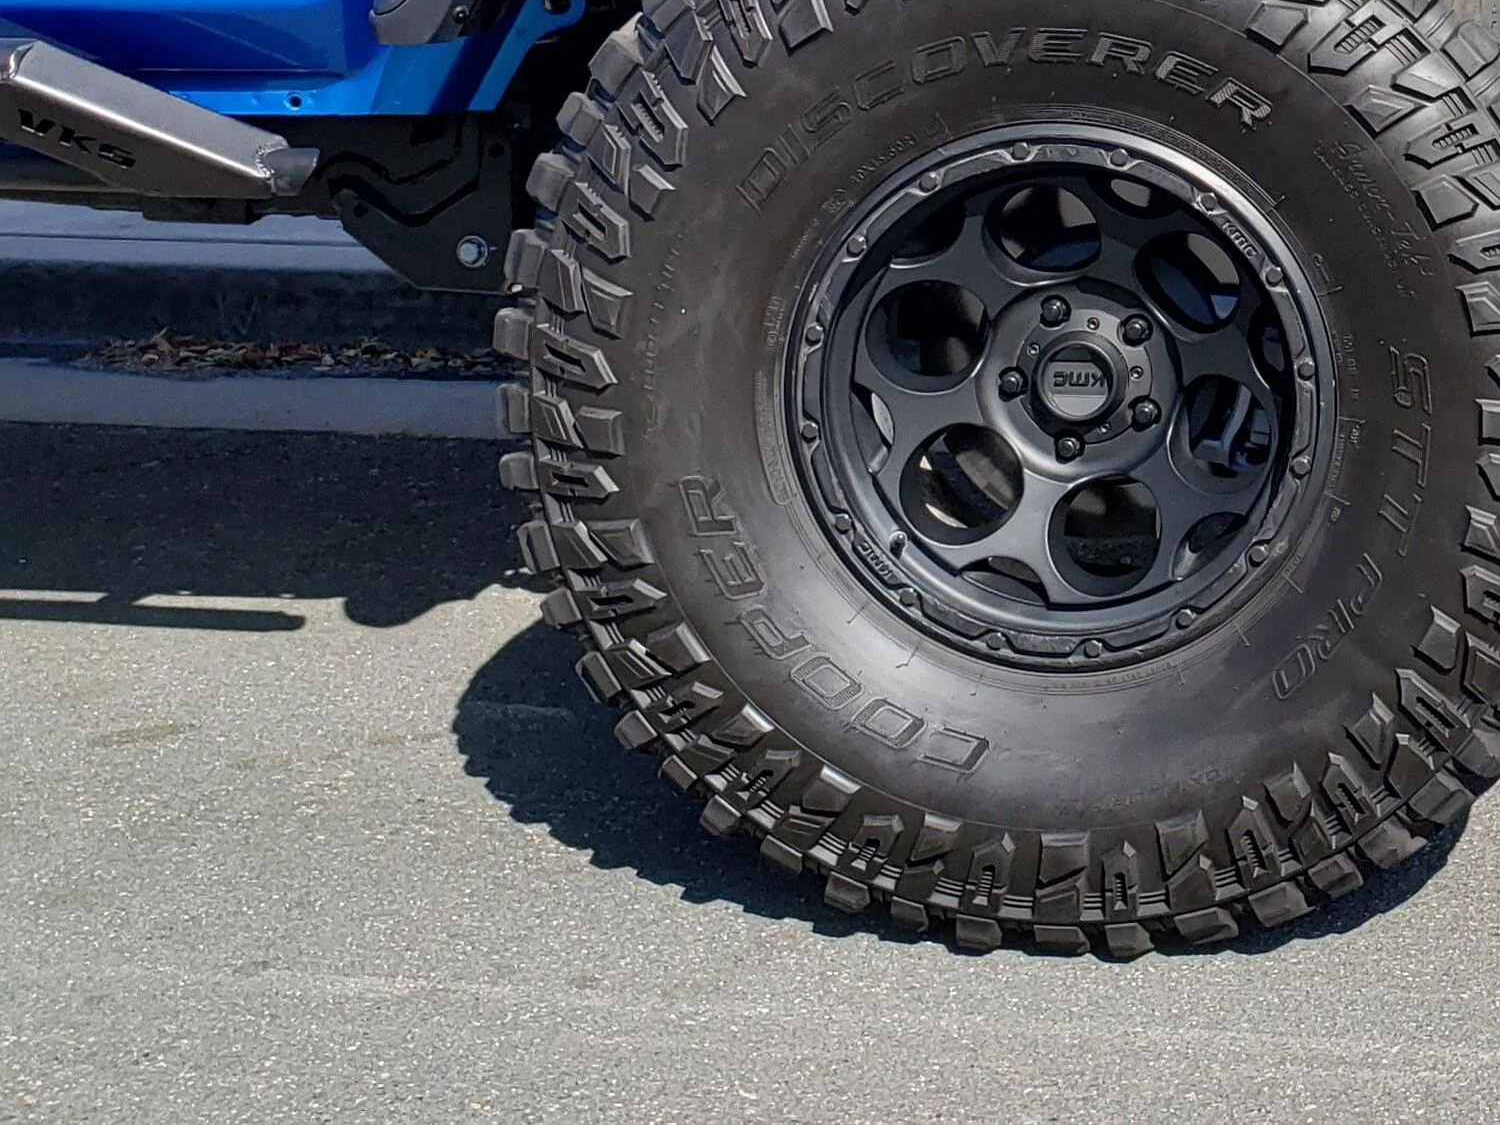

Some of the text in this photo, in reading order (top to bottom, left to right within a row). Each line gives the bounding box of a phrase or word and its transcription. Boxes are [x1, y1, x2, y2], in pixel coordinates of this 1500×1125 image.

[17, 107, 137, 168] VKS
[735, 27, 1276, 215] DISCOVERER
[1222, 221, 1257, 258] KMC
[1053, 371, 1106, 388] KMC
[1272, 345, 1432, 700] STT PRO
[678, 475, 993, 774] COOPER
